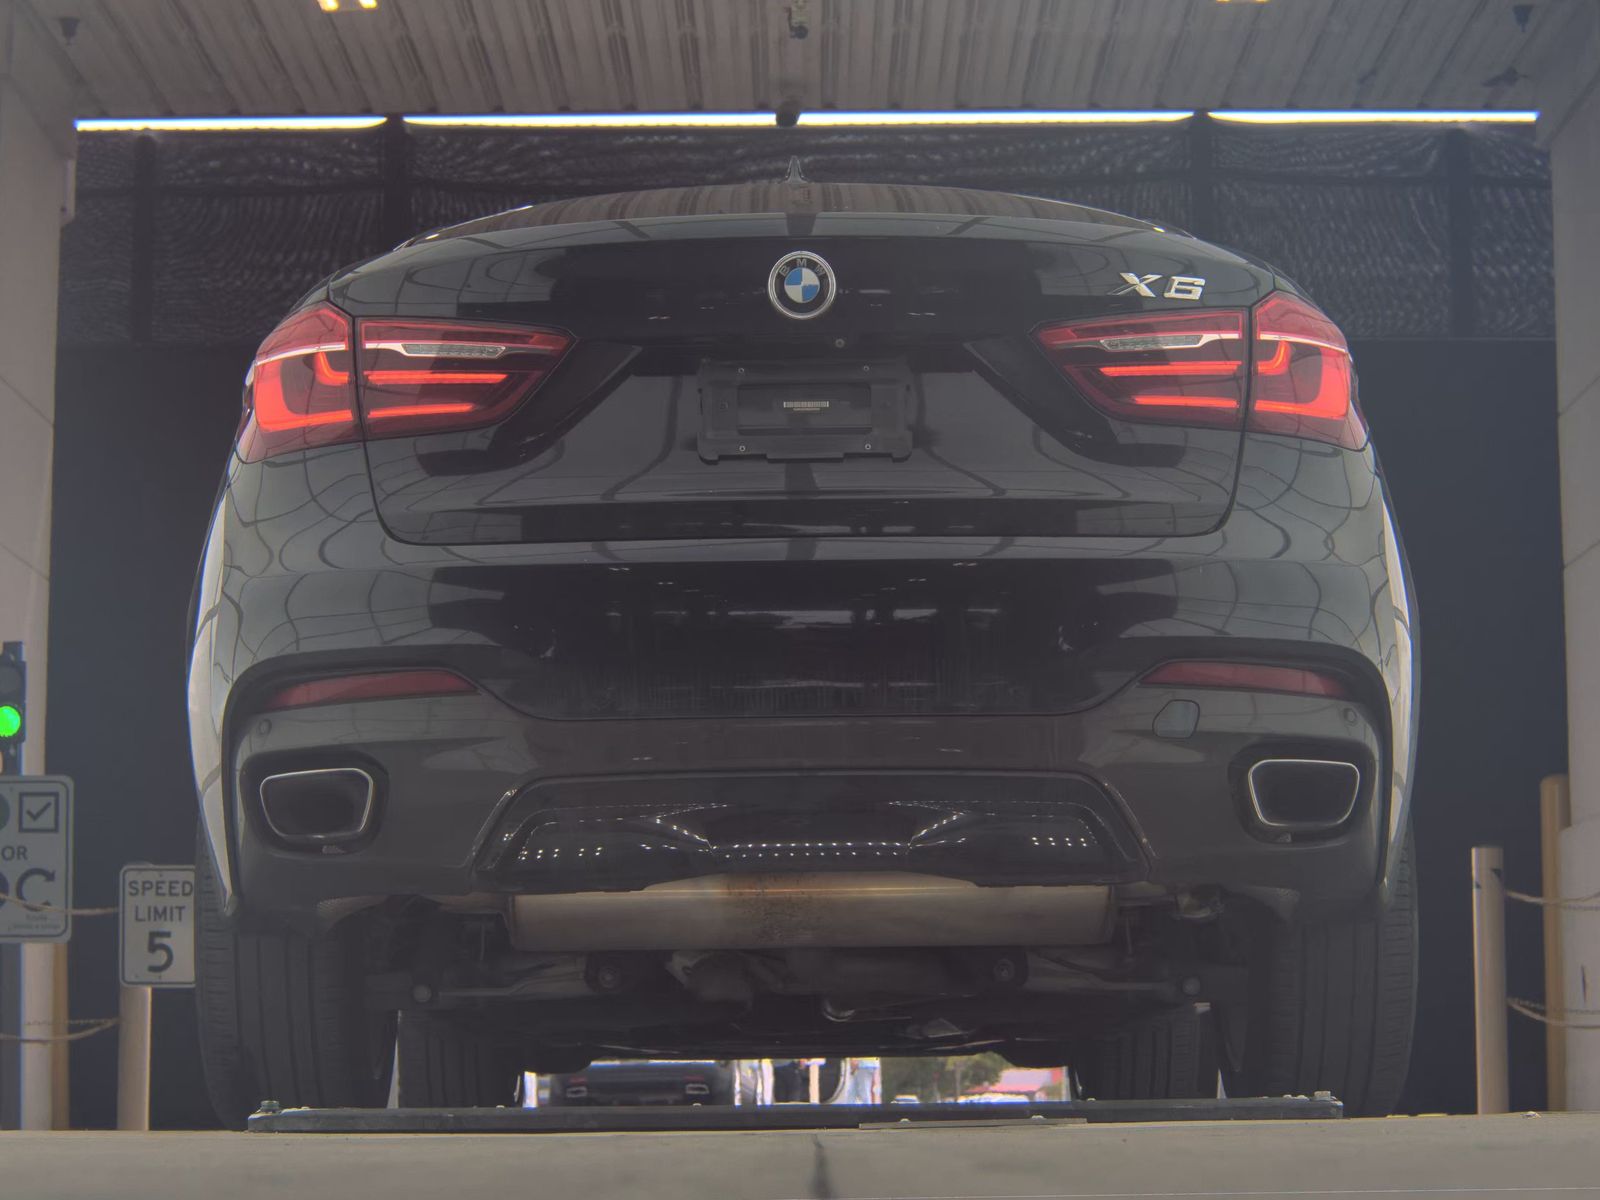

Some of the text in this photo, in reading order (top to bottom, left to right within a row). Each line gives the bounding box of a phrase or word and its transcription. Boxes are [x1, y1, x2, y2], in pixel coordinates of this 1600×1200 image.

[779, 258, 826, 277] BMW
[1106, 272, 1206, 300] X6
[1, 845, 29, 861] OR
[128, 880, 194, 897] SPEED
[135, 905, 186, 922] LIMIT
[148, 931, 174, 973] 5
